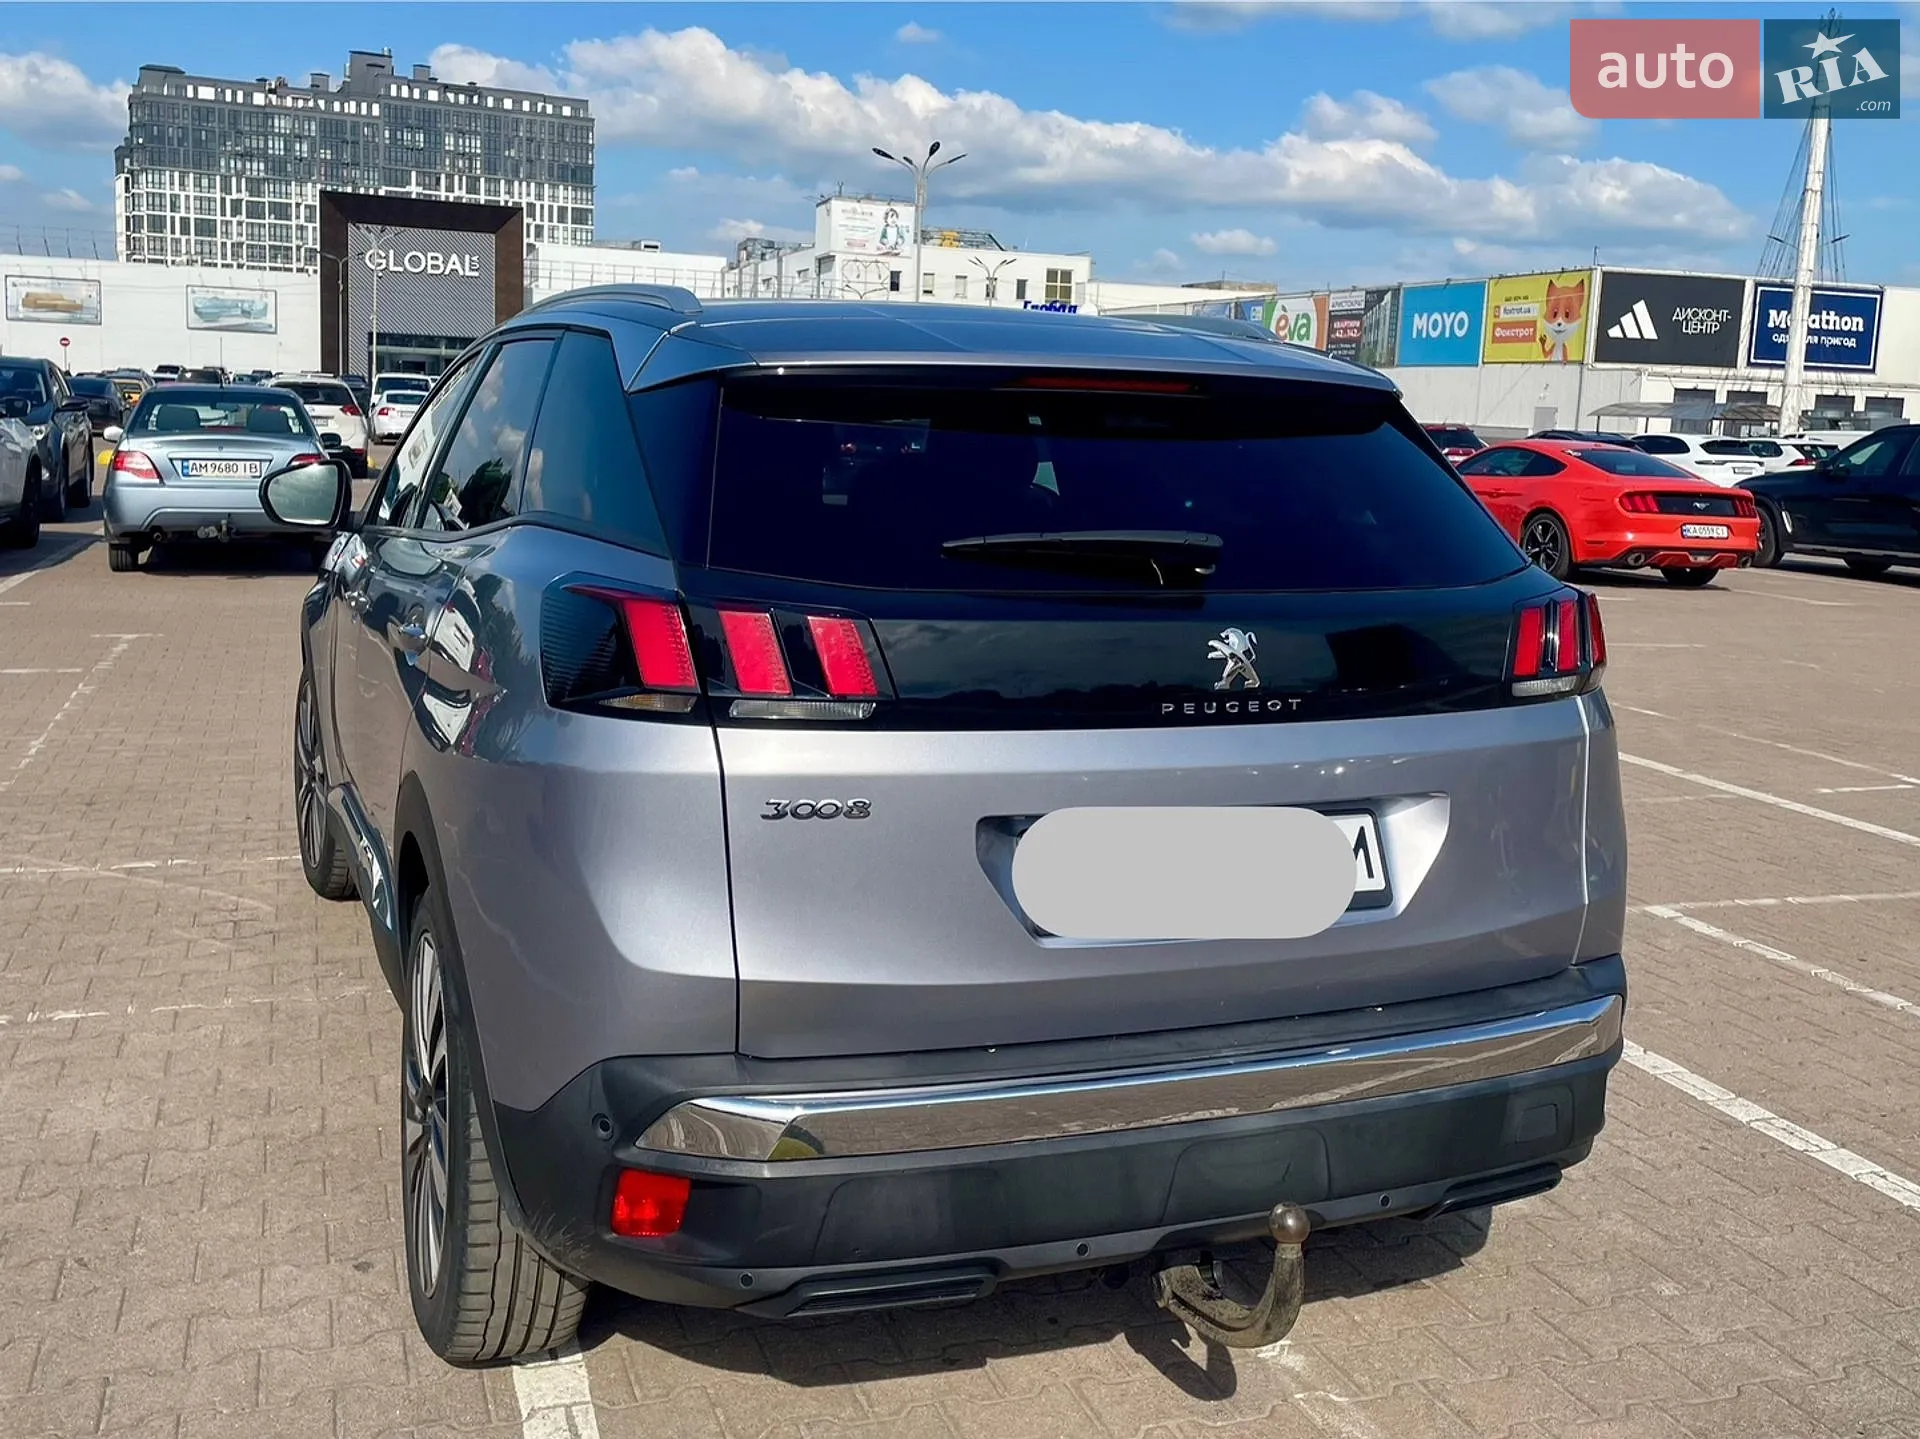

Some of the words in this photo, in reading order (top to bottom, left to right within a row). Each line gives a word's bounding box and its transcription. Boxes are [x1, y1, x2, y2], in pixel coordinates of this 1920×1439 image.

[365, 249, 480, 277] GLOBAL
[1412, 310, 1469, 338] MOYO
[1672, 307, 1732, 322] ДИСКОНТ-
[1767, 309, 1864, 332] Mathon
[1682, 320, 1720, 334] ЦЕНТР
[190, 462, 208, 473] AM
[210, 462, 239, 474] 9680
[1161, 698, 1302, 715] PEUGEOT
[760, 798, 872, 820] 3008
